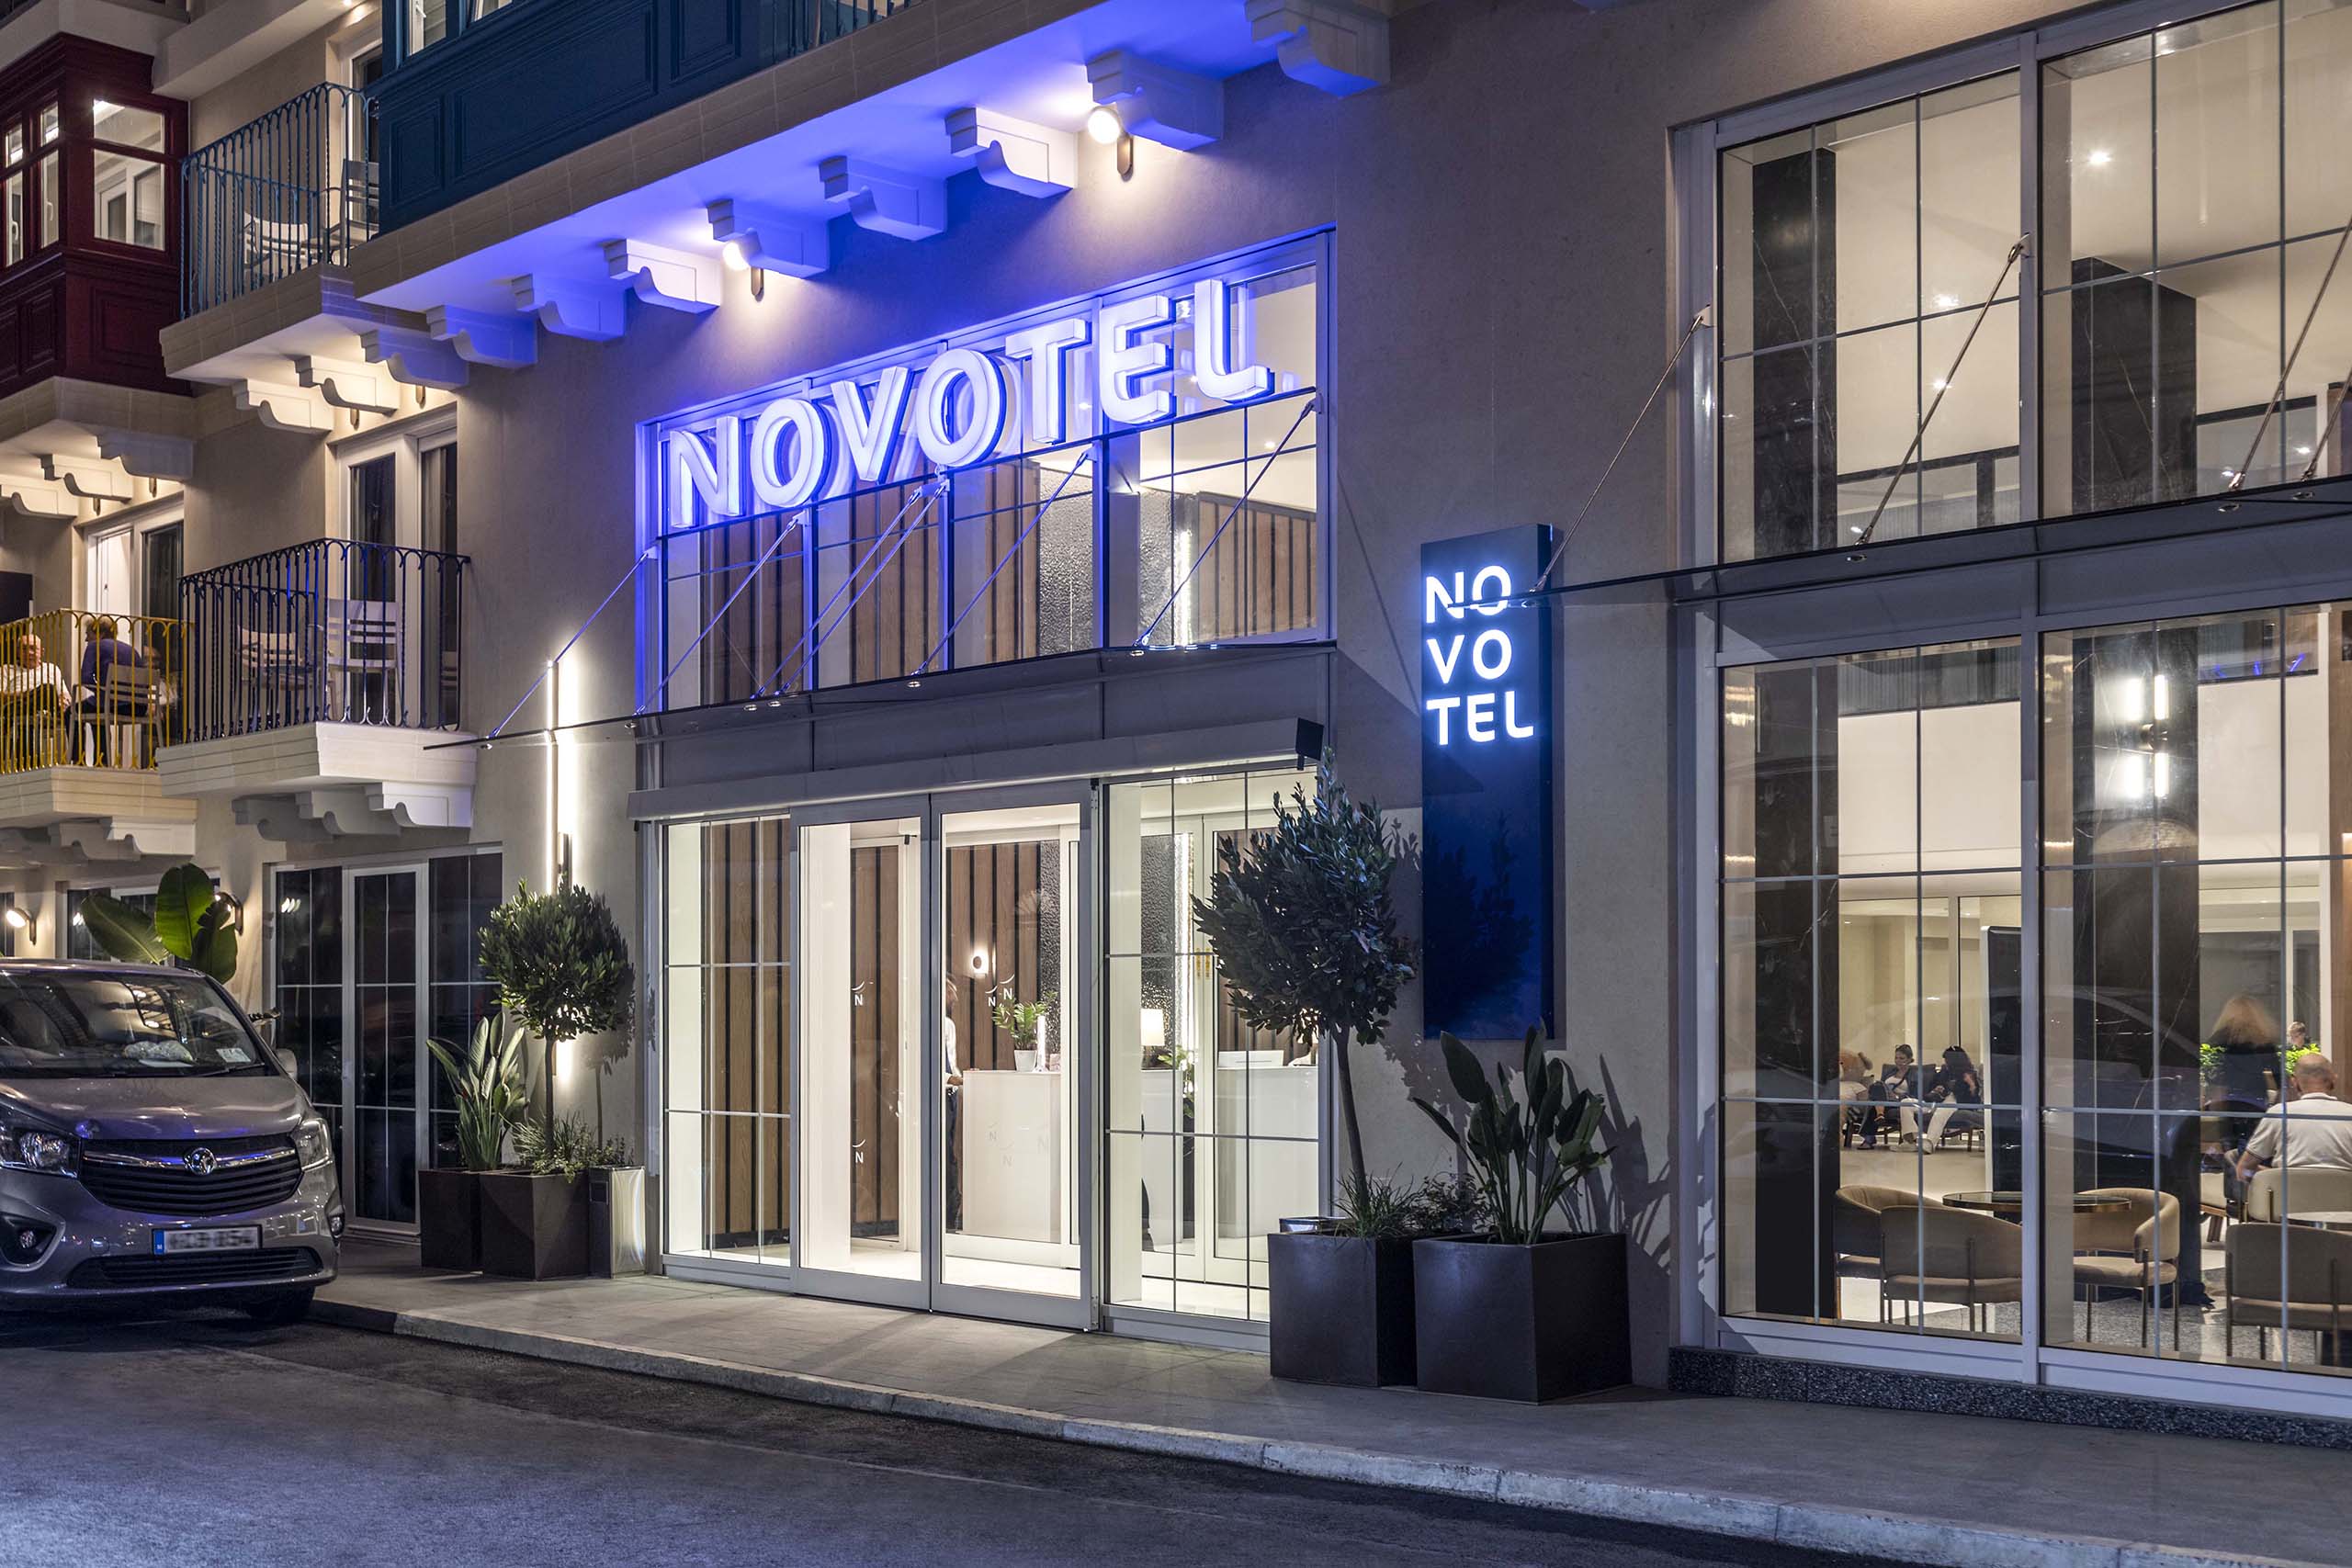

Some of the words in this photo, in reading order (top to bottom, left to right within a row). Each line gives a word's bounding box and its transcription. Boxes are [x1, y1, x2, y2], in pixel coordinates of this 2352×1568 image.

[669, 278, 1274, 528] NOVOTEL
[1426, 565, 1511, 624] NO
[1427, 629, 1512, 684] VO
[1427, 691, 1534, 745] TEL
[854, 994, 864, 1006] N
[988, 997, 996, 1007] N
[1003, 987, 1012, 1000] N
[855, 1151, 864, 1164] N
